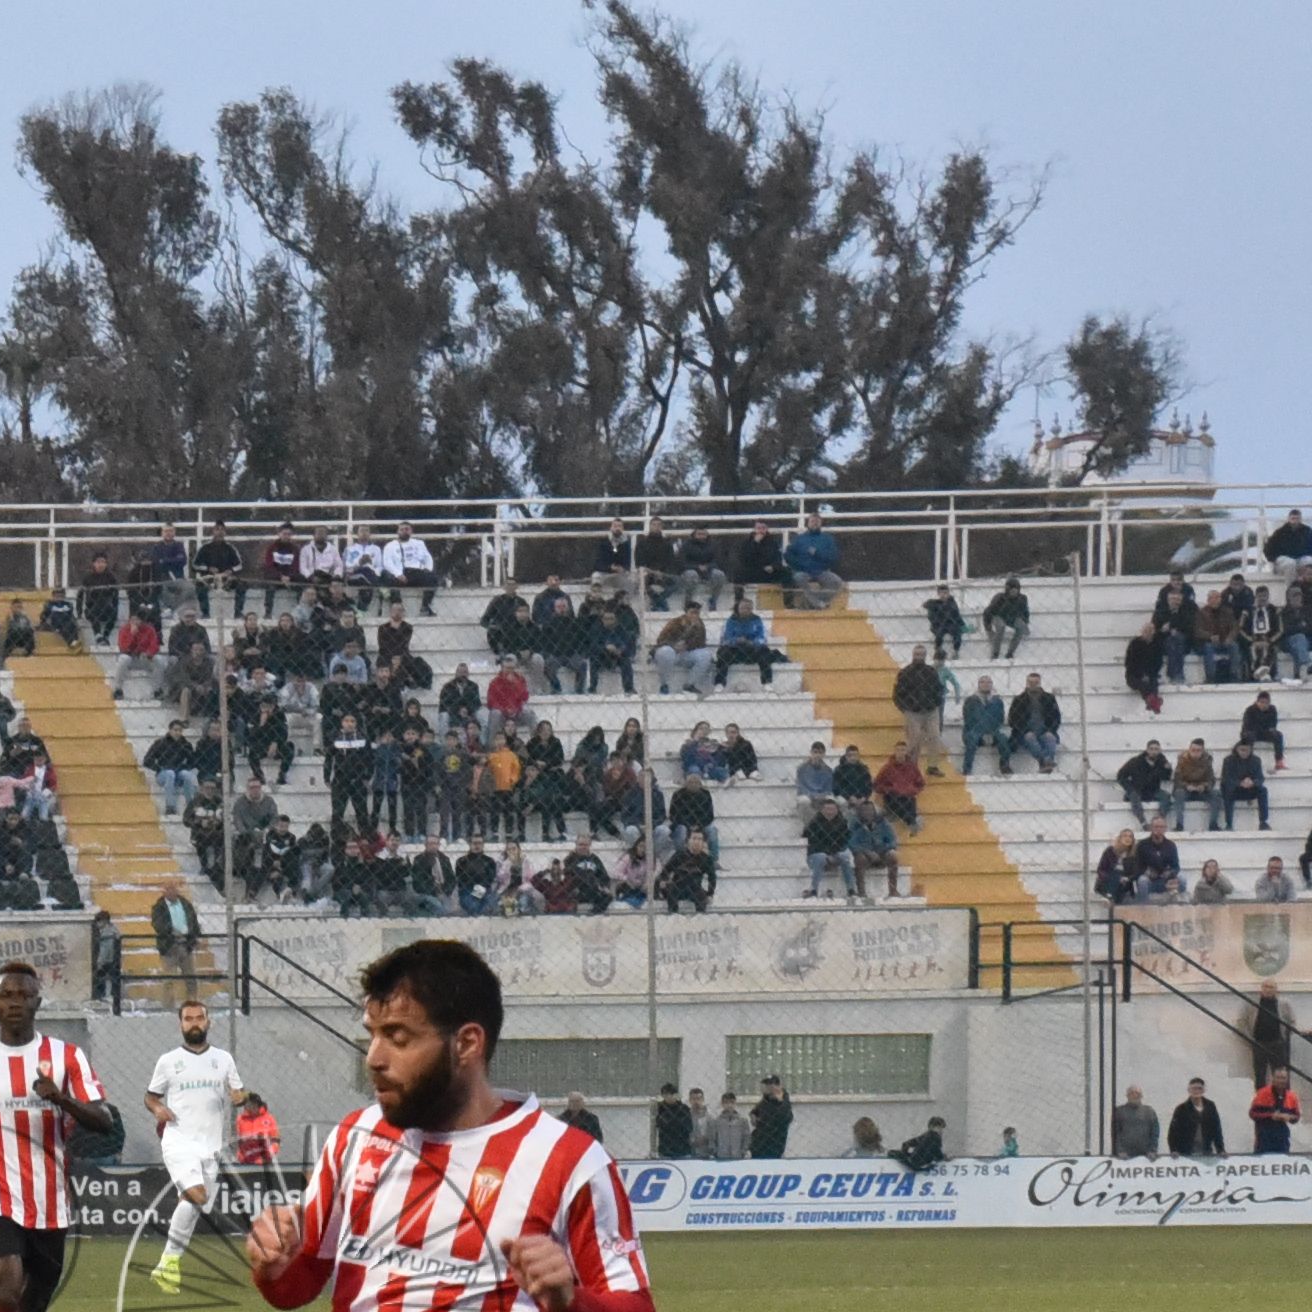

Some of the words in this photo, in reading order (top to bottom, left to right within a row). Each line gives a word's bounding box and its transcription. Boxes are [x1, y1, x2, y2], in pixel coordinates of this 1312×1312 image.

[33, 953, 66, 968] BASE
[953, 1165, 968, 1176] 75
[974, 1165, 989, 1176] 78
[994, 1165, 1010, 1176] 94
[1111, 1164, 1200, 1179] IMPRENTA
[1216, 1162, 1311, 1177] PAPELERÍA
[71, 1175, 118, 1196] Ven
[127, 1180, 141, 1196] a
[1028, 1159, 1311, 1225] Olimpia
[686, 1212, 784, 1224] CONSTRUCCIONES
[795, 1210, 885, 1223] EQUIPAMIENTOS
[896, 1209, 957, 1221] REFORMAS
